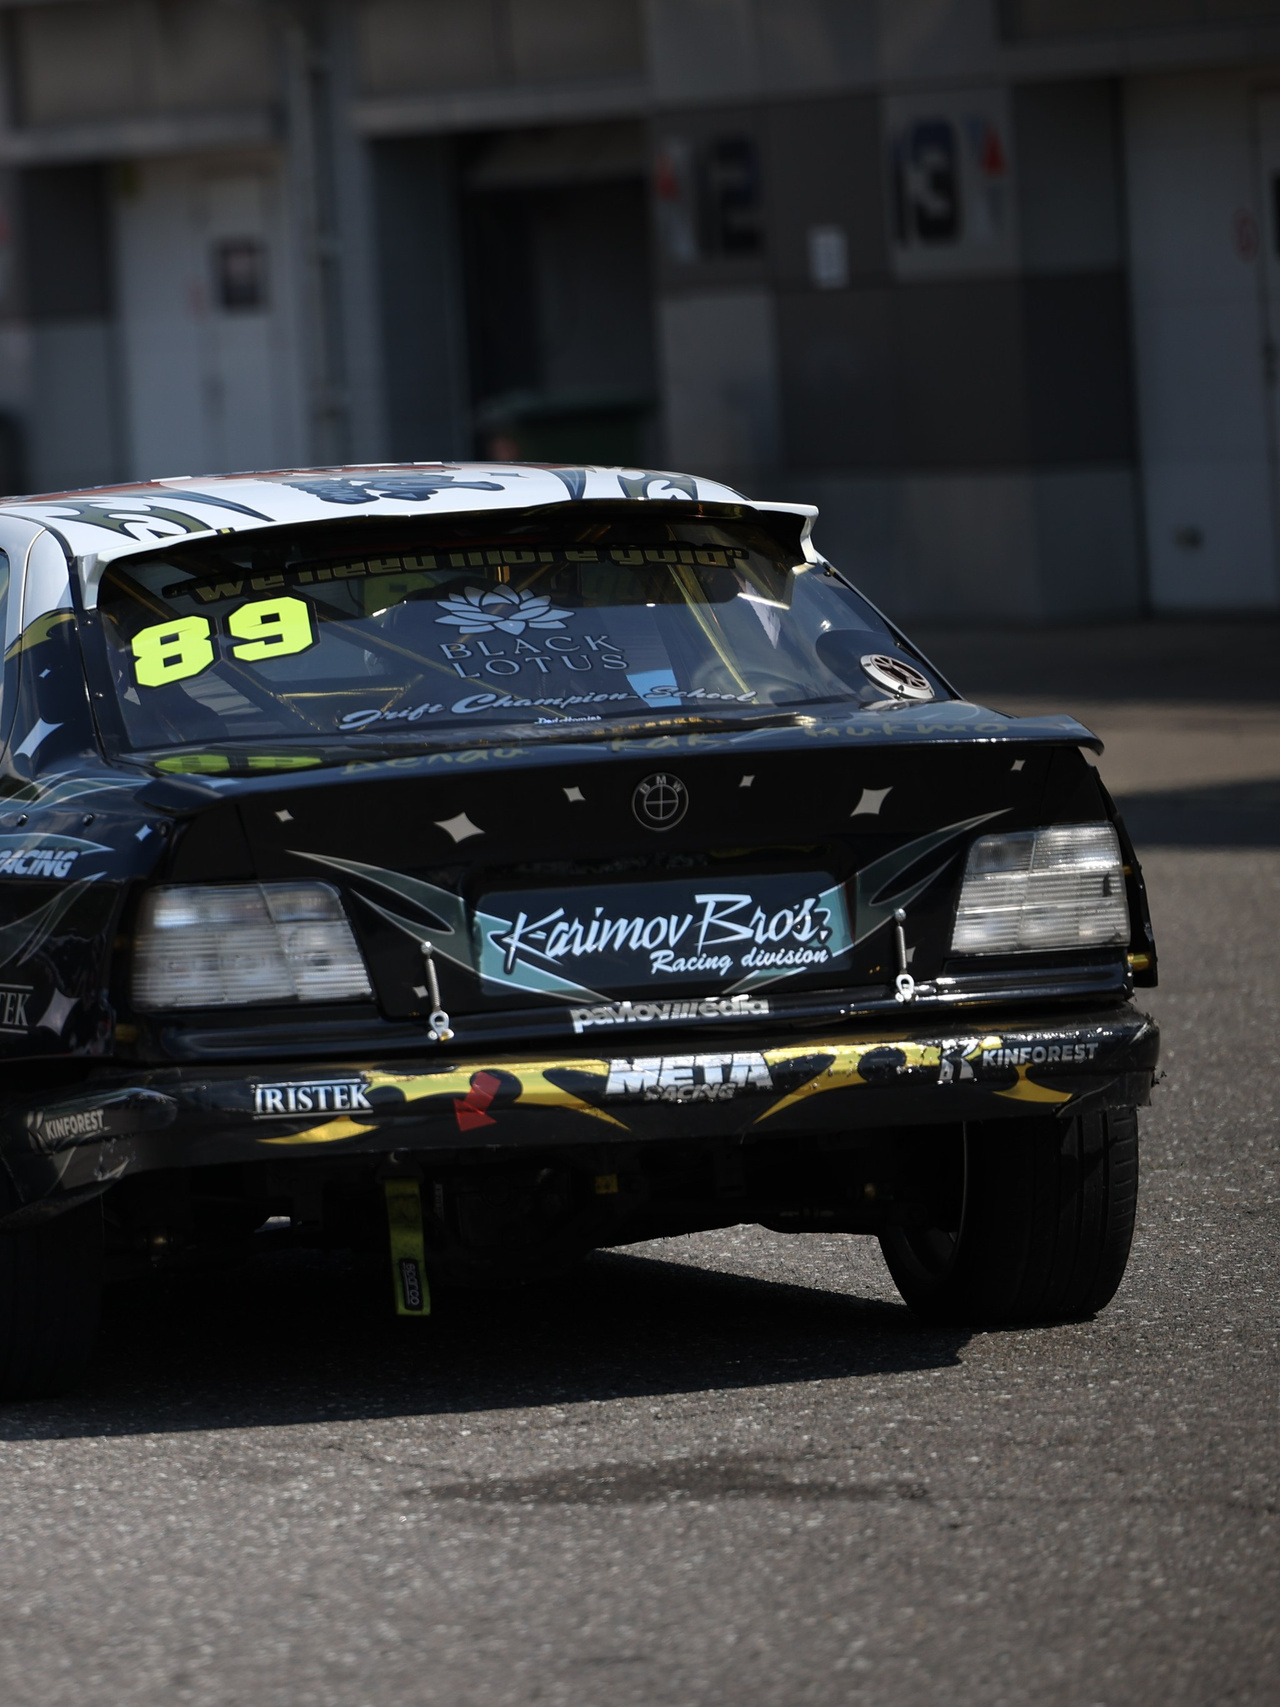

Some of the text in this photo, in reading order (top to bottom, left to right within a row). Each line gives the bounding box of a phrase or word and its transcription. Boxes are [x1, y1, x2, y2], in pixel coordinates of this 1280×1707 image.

[130, 595, 314, 688] 89
[438, 635, 625, 660] BLACK
[450, 653, 630, 679] LOTUS
[451, 690, 641, 715] Champion
[645, 685, 758, 704] School
[502, 906, 694, 971] Karimov
[649, 945, 830, 976] Racing division
[982, 1043, 1099, 1067] KINFOREST
[606, 1052, 773, 1095] META
[255, 1084, 373, 1113] IRISTEK
[644, 1082, 737, 1101] RACING
[45, 1109, 104, 1140] KINFOREST
[406, 1261, 420, 1306] sparco
